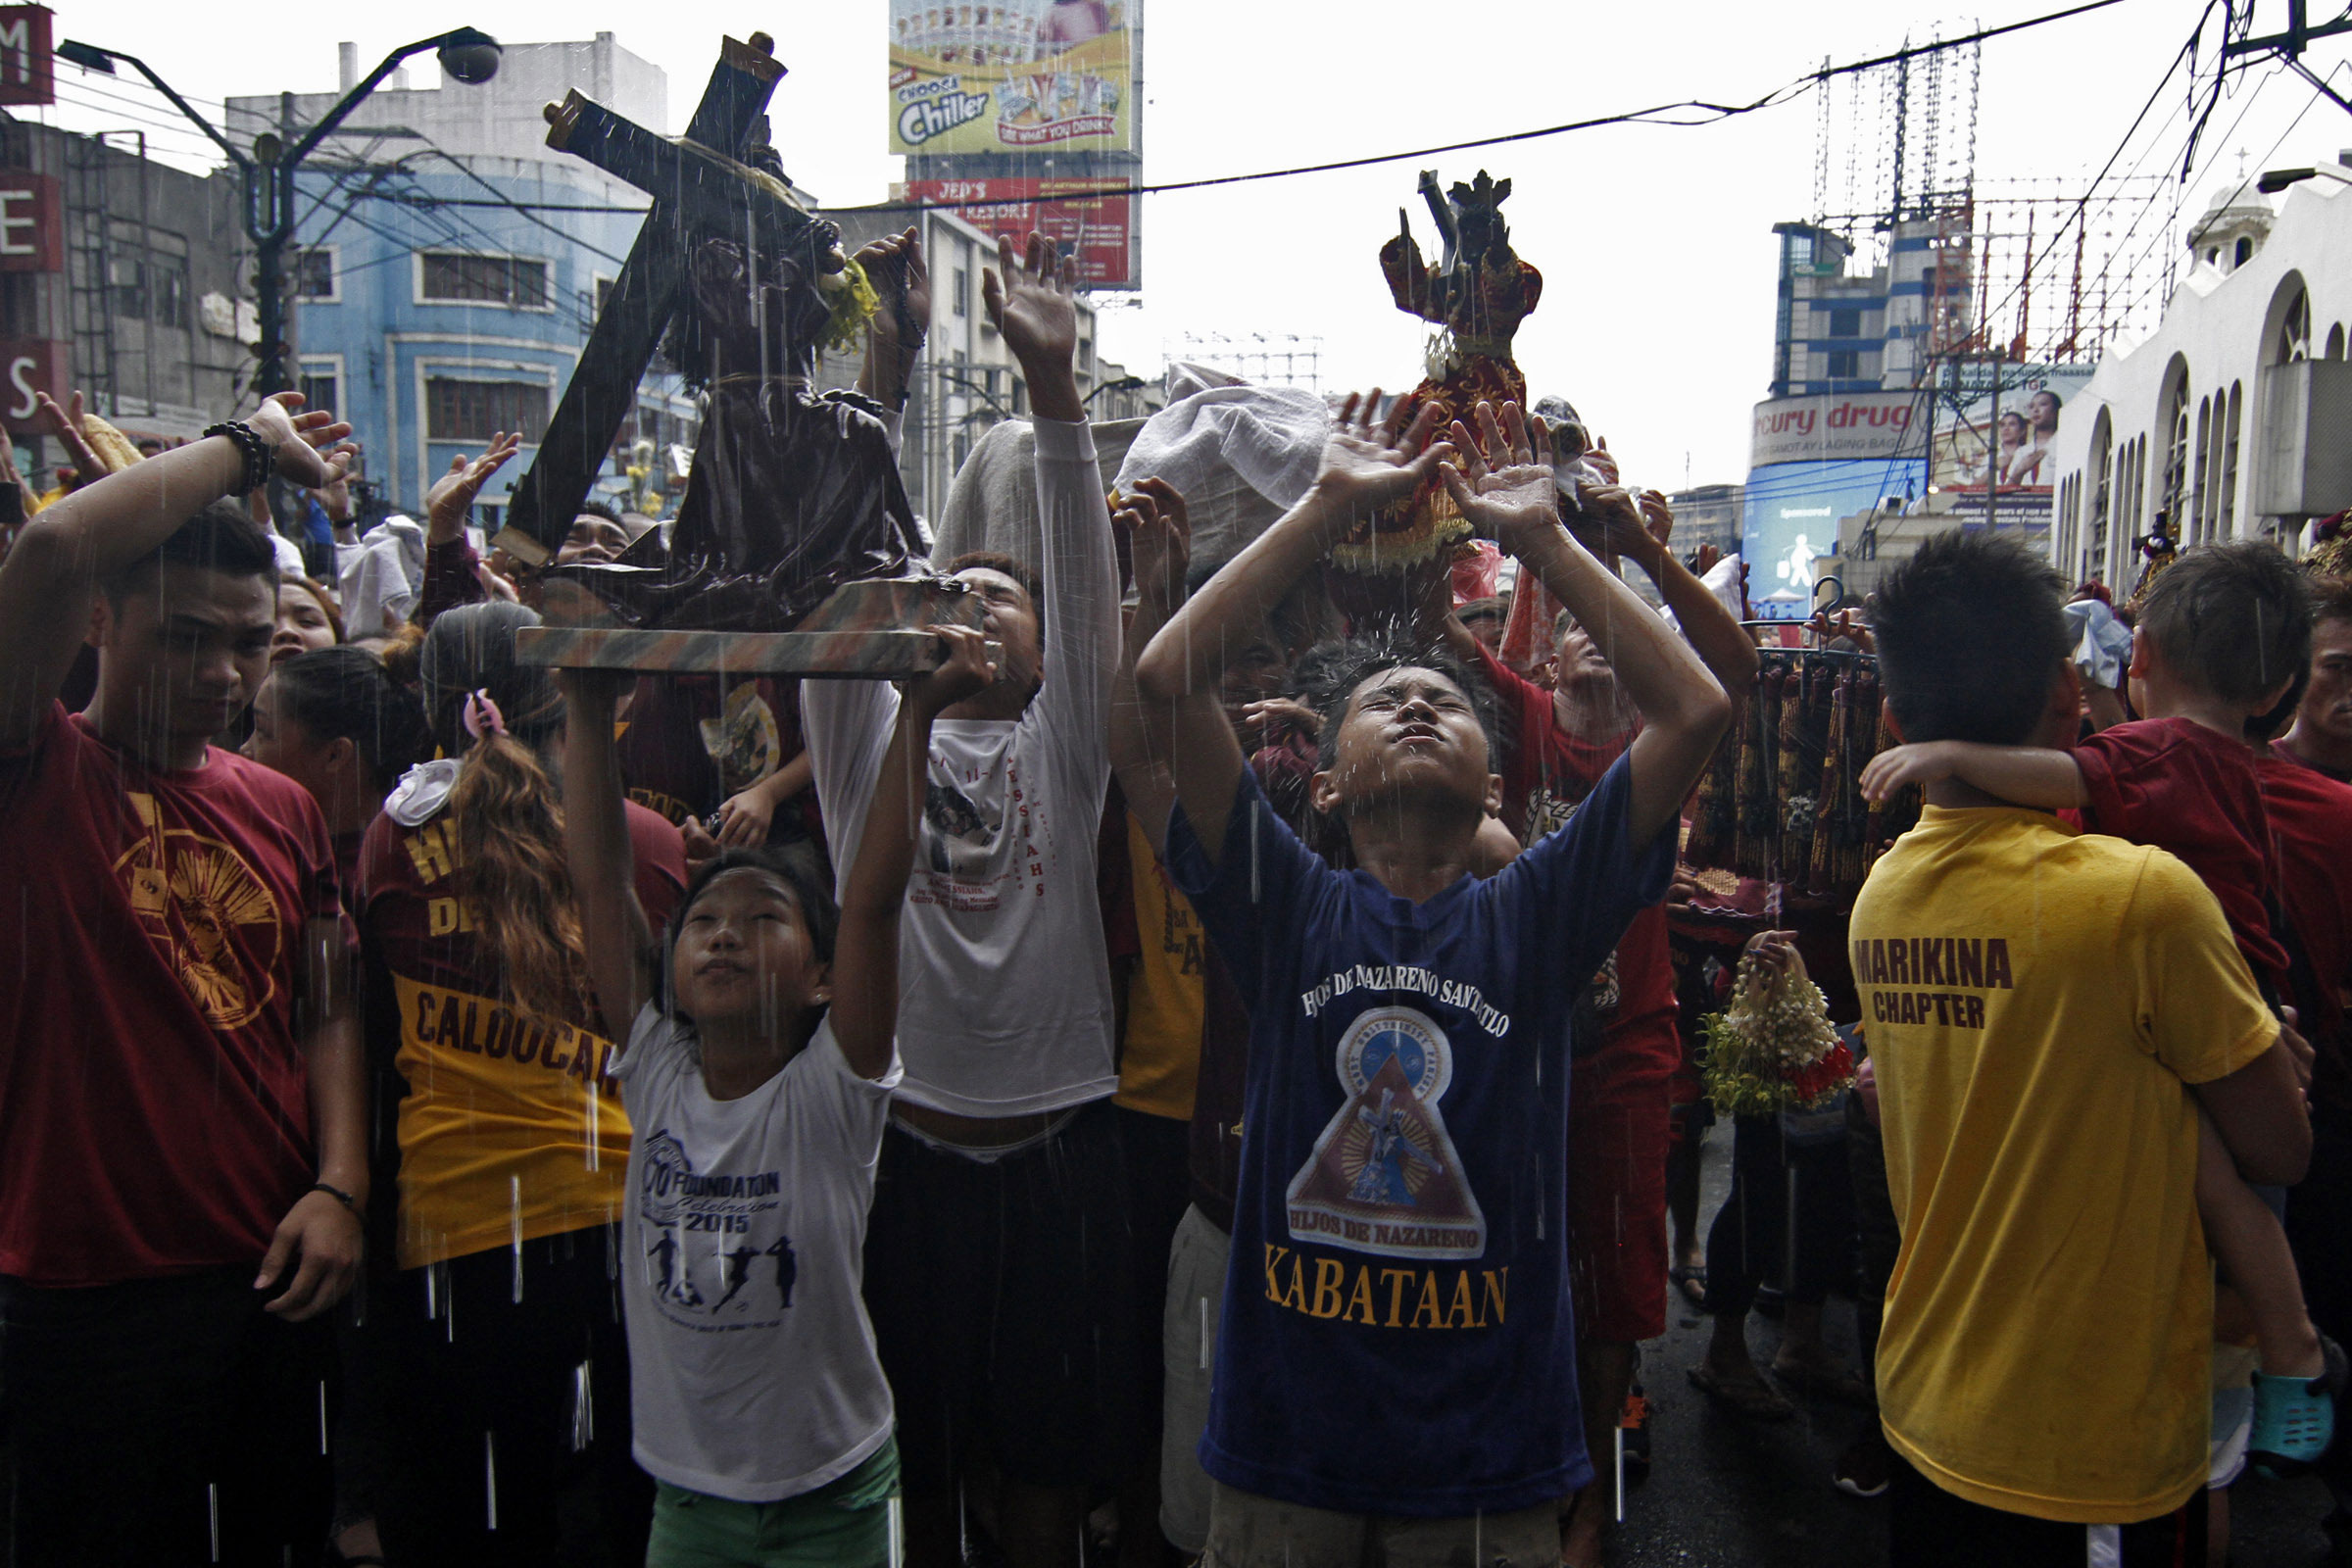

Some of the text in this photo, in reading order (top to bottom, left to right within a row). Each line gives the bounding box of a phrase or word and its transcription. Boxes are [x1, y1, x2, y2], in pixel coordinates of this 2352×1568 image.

[899, 92, 989, 145] Chiller
[1019, 128, 1047, 140] WHAT
[939, 182, 986, 199] JED'S
[1827, 402, 1912, 432] drug
[1334, 967, 1354, 996] DE
[1354, 964, 1439, 997] NAZARENO
[1854, 938, 2014, 989] MARIKINA
[1873, 991, 1985, 1029] CHAPTER
[416, 992, 620, 1097] CALOOCAN
[685, 1212, 750, 1234] 2015
[1289, 1209, 1479, 1249] HIJOS DE NAZARENO
[1263, 1242, 1509, 1329] KABATAAN
